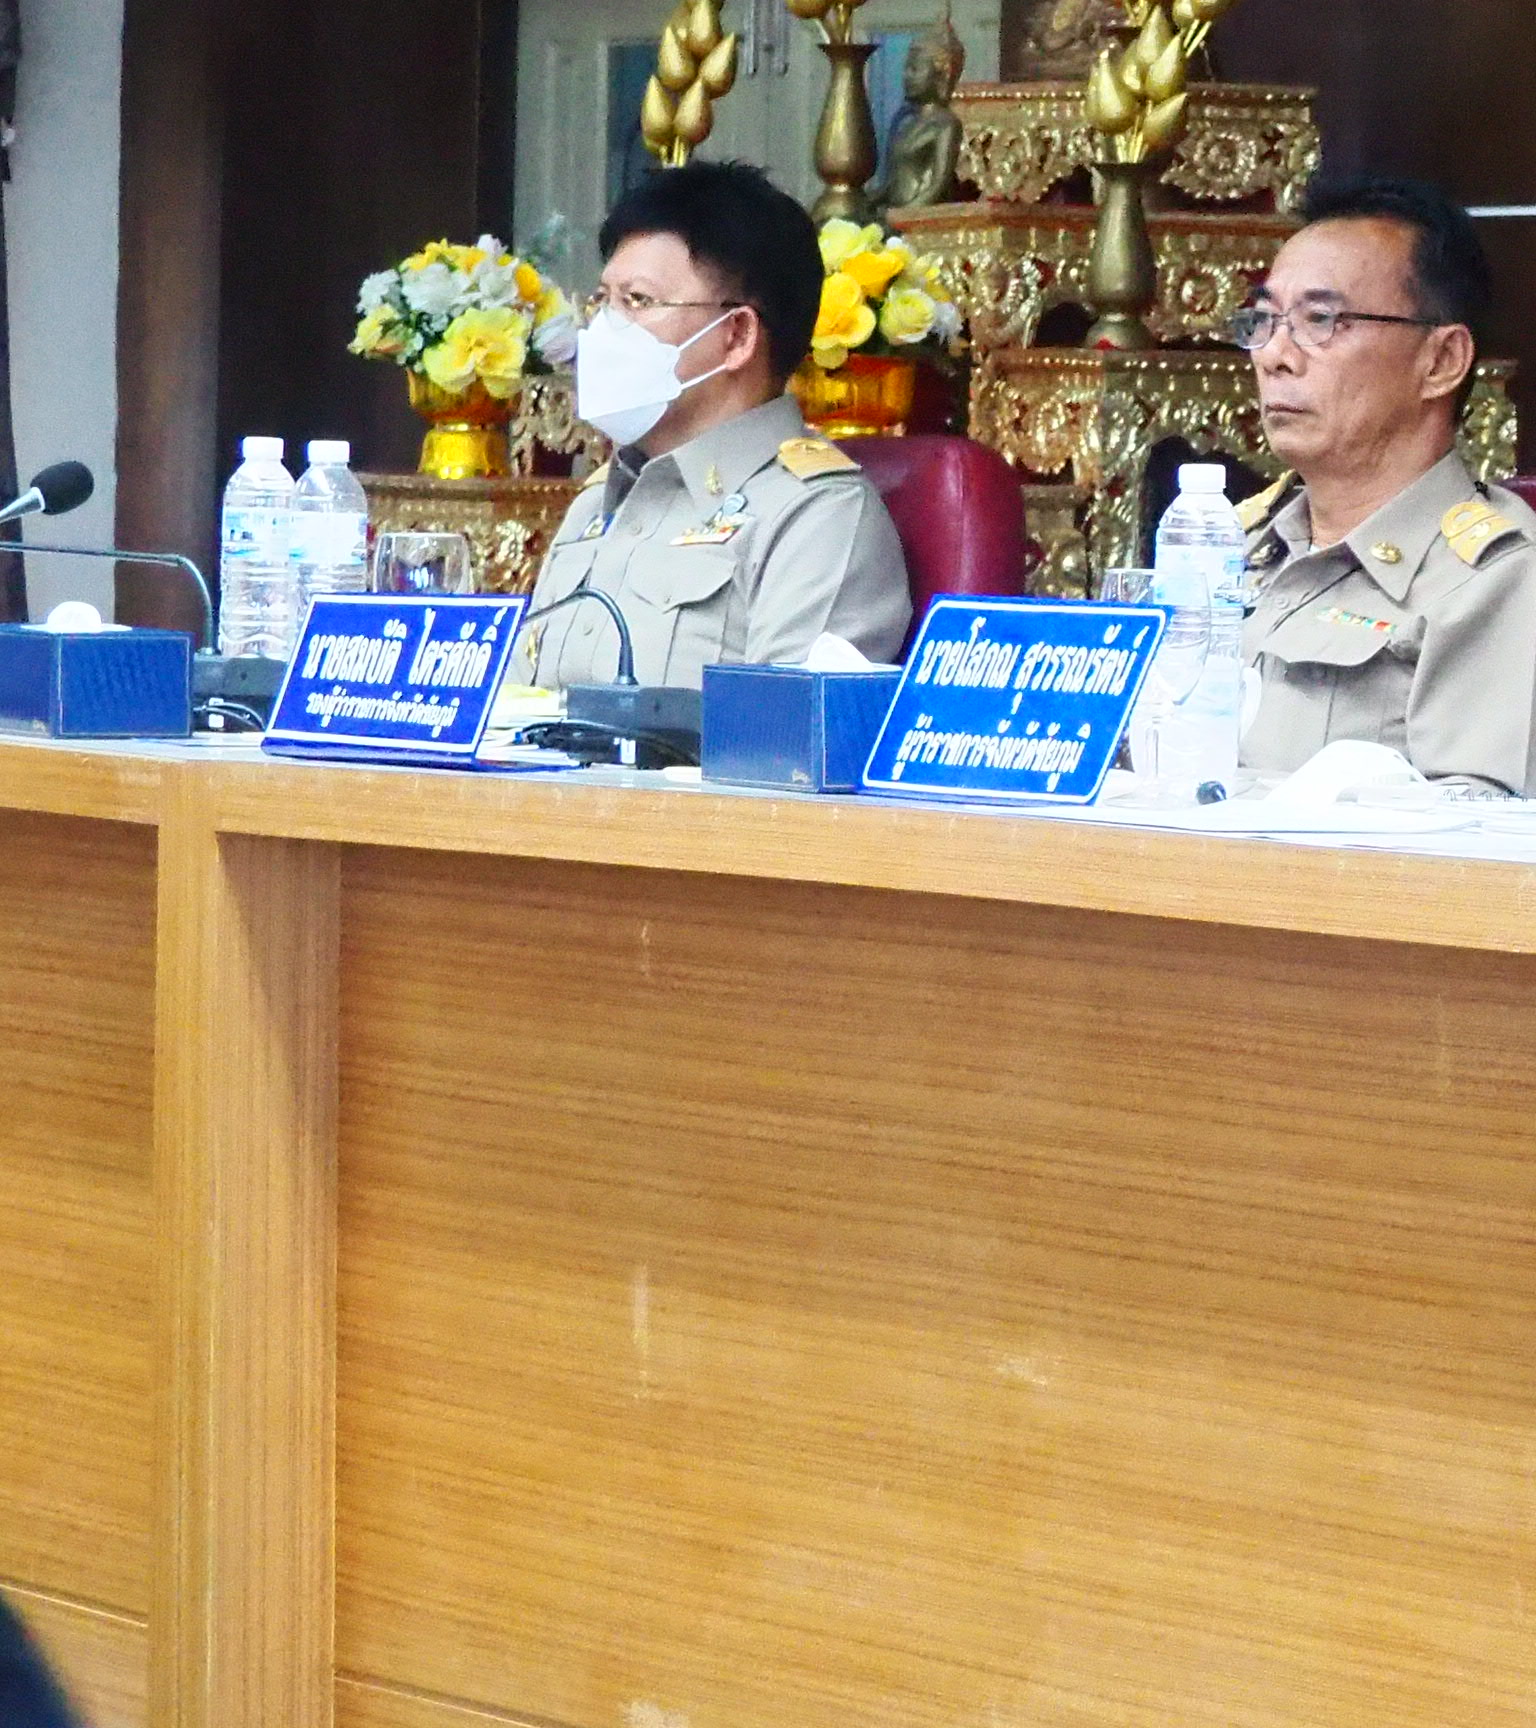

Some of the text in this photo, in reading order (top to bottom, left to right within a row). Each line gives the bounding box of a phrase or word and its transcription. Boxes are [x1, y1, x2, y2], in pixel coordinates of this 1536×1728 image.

[302, 619, 407, 684] นายสมบัติ
[916, 617, 1149, 714] นายโสภณ สุวรรณรัตน์
[891, 714, 1090, 792] ผู้ว่าราชการจังหวัดชัยภูมิ
